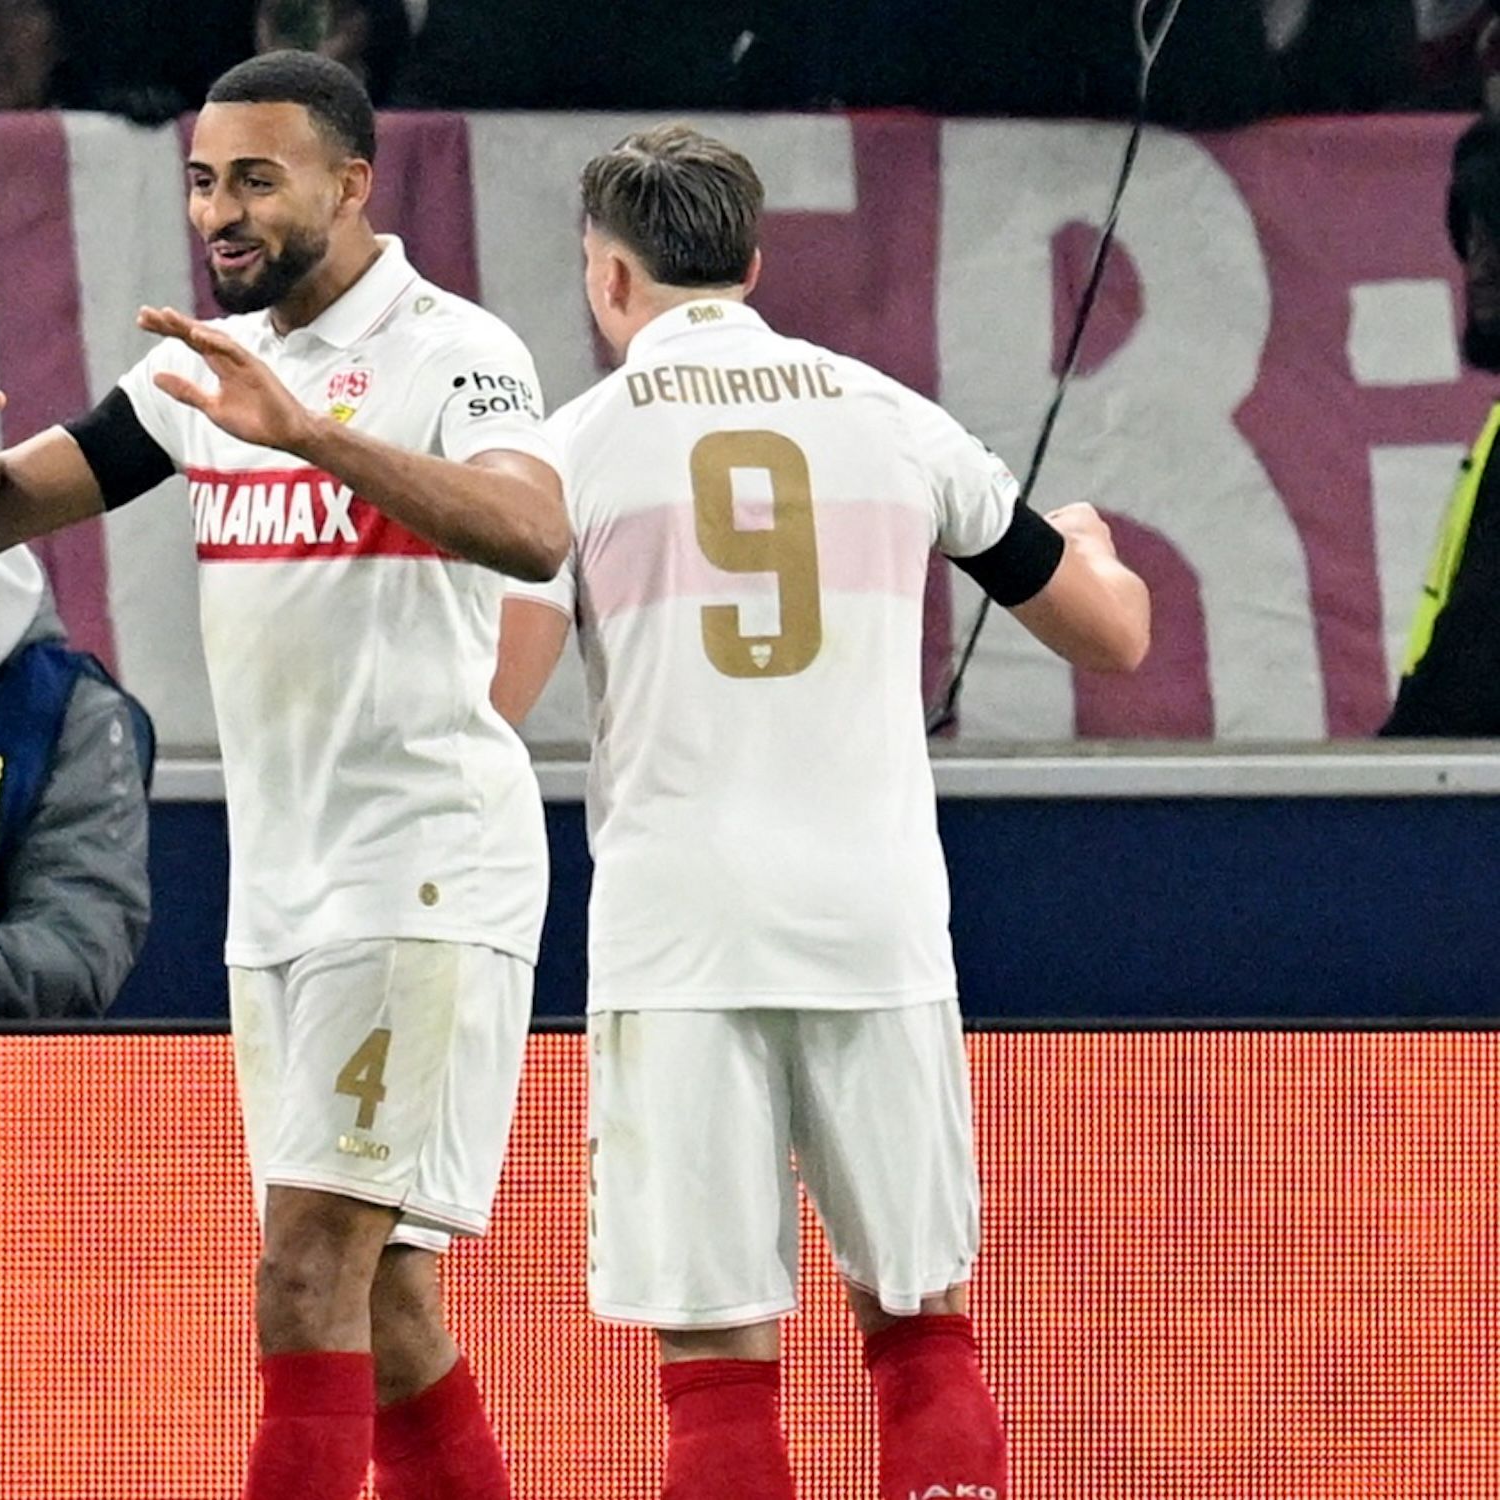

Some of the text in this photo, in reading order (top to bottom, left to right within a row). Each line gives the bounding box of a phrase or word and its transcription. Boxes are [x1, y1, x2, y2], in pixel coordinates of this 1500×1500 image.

[626, 357, 843, 408] DEMIROVIĆ
[690, 430, 822, 679] 9
[335, 1028, 392, 1130] 4
